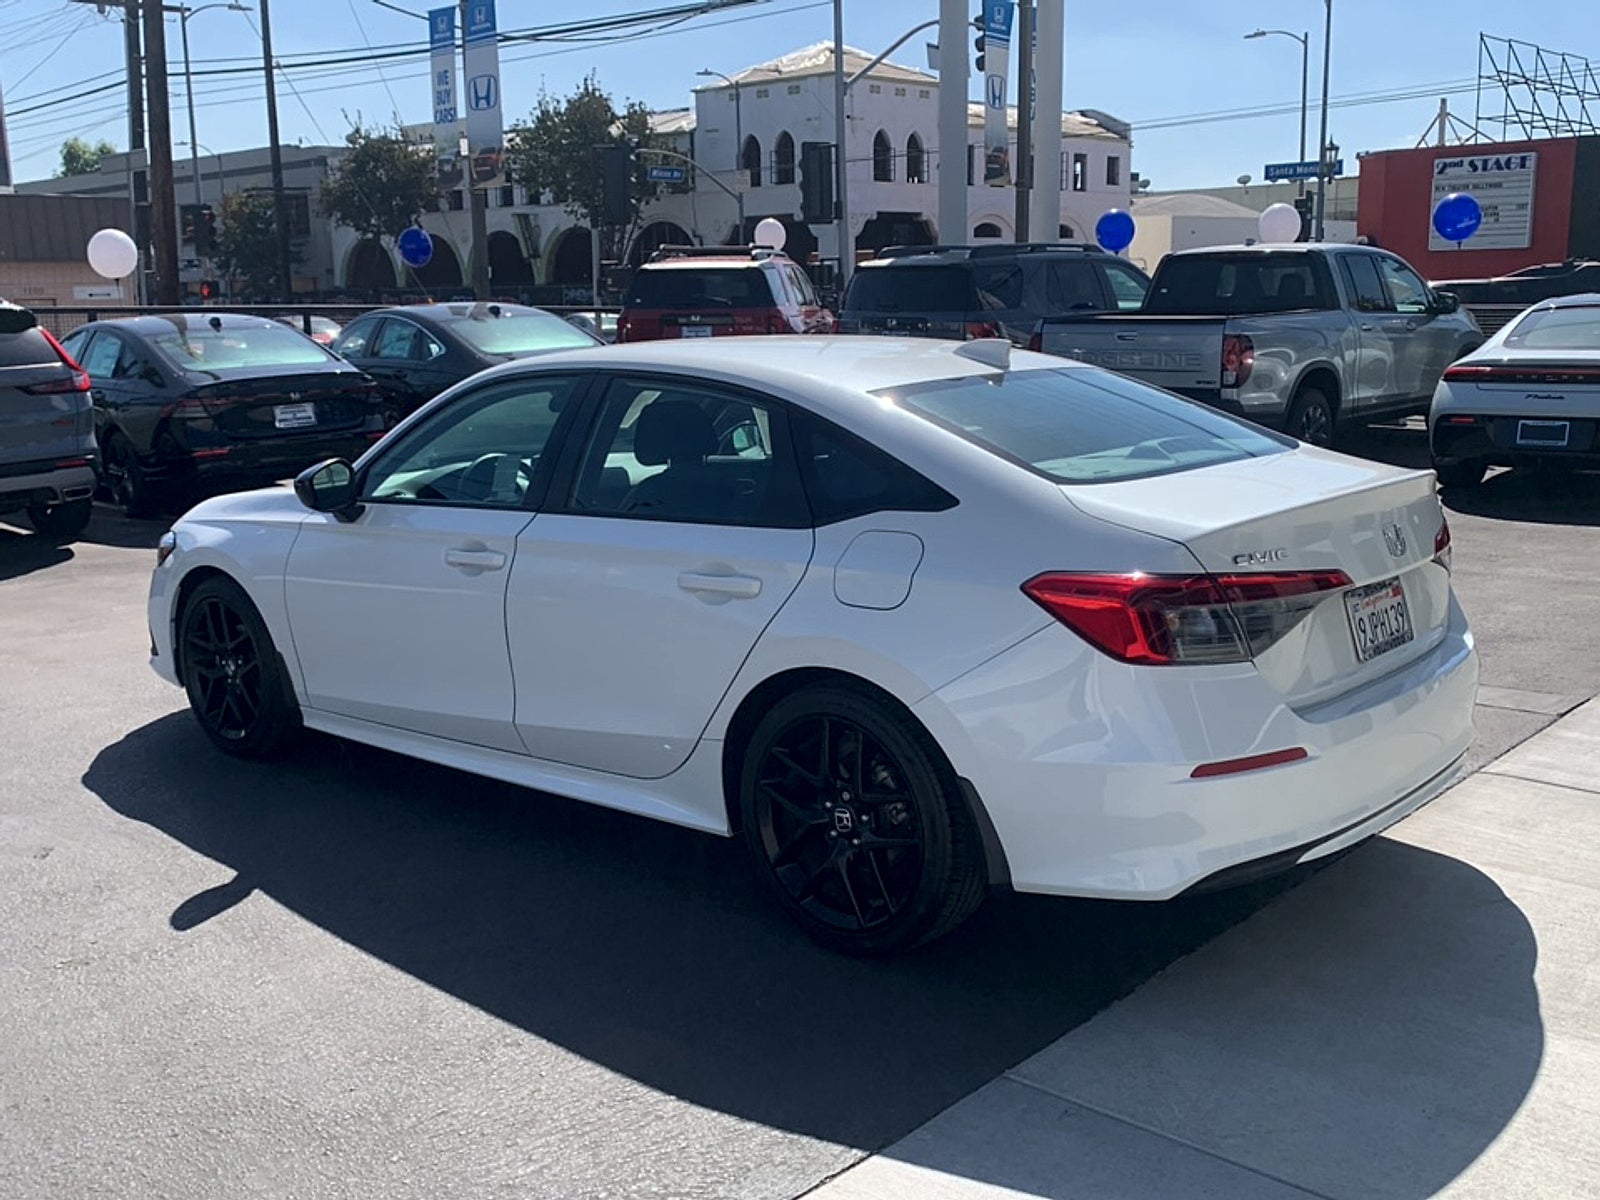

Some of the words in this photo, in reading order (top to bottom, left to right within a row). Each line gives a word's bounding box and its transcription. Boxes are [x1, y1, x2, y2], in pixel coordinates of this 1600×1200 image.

[437, 88, 451, 106] BUY
[1268, 165, 1294, 177] Santa
[1436, 160, 1464, 175] 2nd
[1467, 155, 1532, 173] STAGE
[1233, 548, 1289, 567] CIVIC
[1358, 602, 1407, 648] 9JPH139
